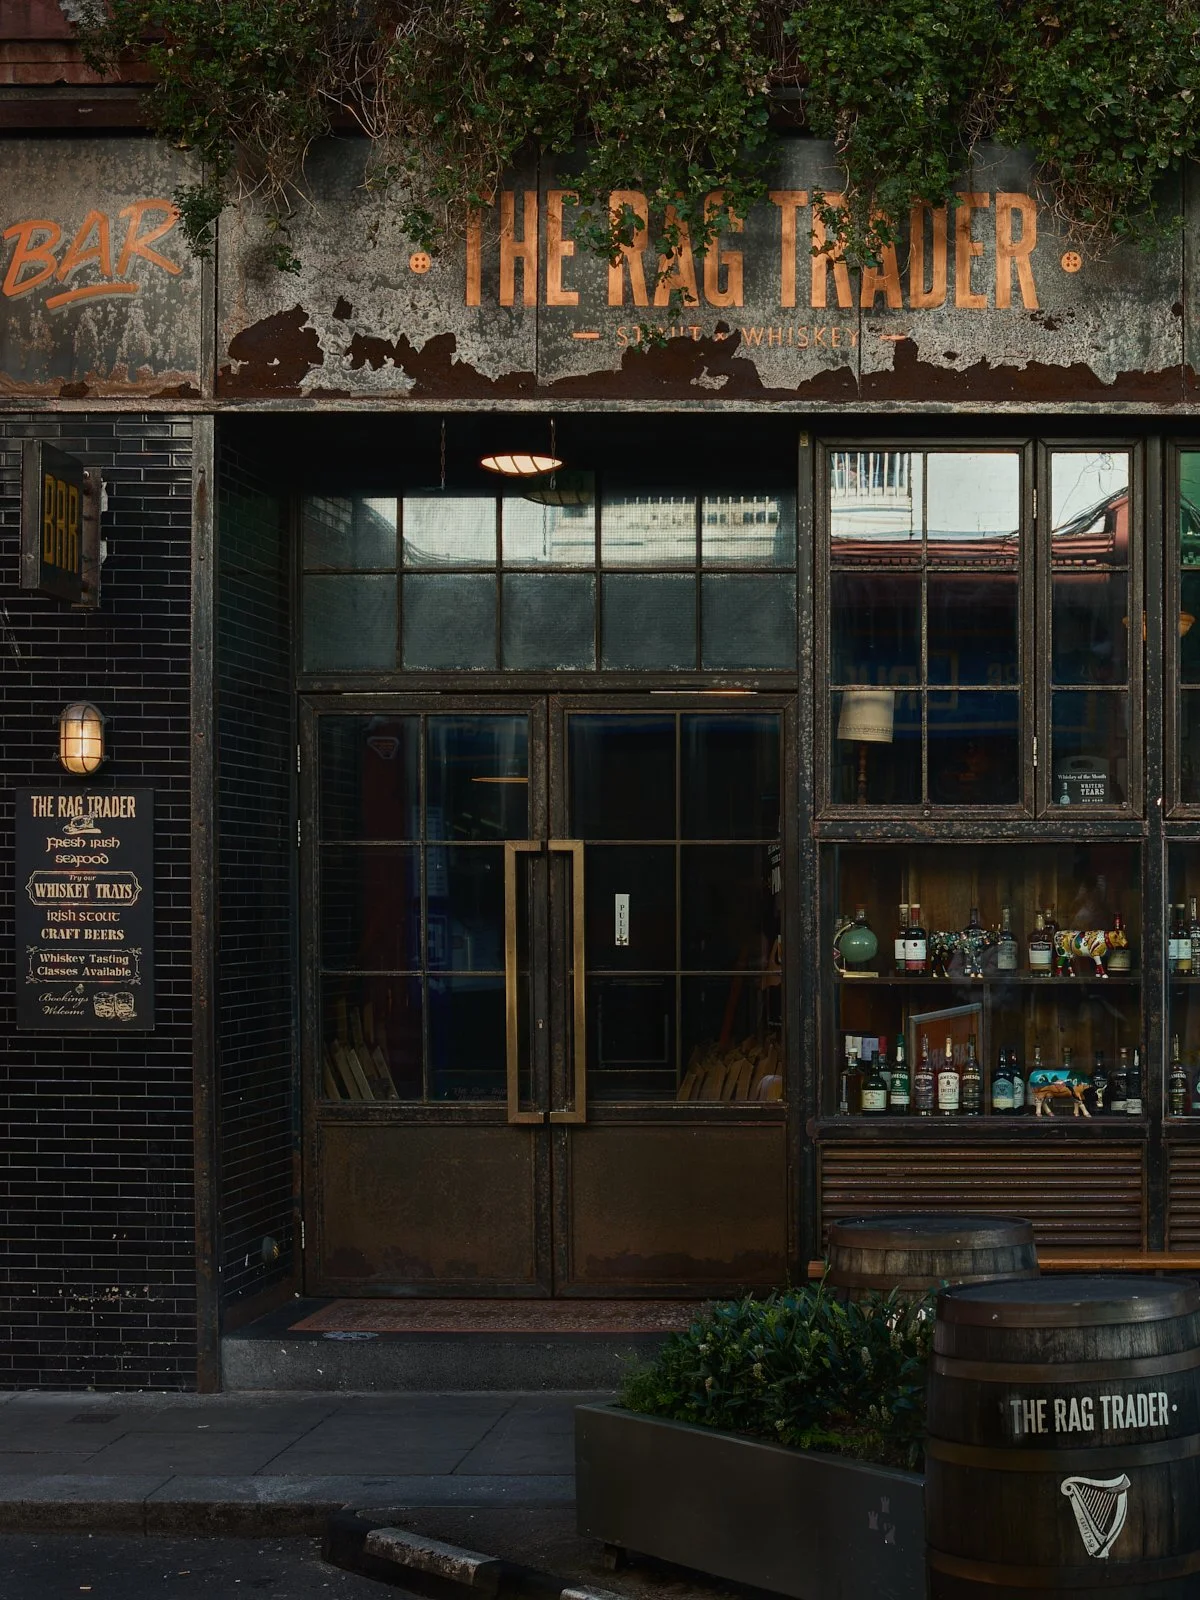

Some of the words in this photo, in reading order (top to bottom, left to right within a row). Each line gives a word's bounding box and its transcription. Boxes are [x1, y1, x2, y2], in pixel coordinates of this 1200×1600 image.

[2, 199, 182, 298] BAR
[456, 190, 580, 307] THE
[608, 190, 745, 308] RAG
[769, 190, 1040, 310] TRADER
[616, 325, 702, 346] STUT
[741, 326, 861, 349] WHISKEY
[43, 473, 79, 574] BAR
[31, 795, 54, 818] THE
[58, 795, 83, 818] RAG
[87, 795, 136, 818] TRADER
[69, 874, 83, 882] Try
[34, 883, 90, 899] WHISKEY
[96, 883, 133, 899] TRAYS
[41, 928, 81, 940] CRAFT
[84, 929, 125, 941] BEERS
[40, 953, 86, 965] Whiskey
[89, 953, 129, 966] Tasting
[37, 966, 79, 976] Classes
[82, 966, 132, 977] Available
[38, 990, 89, 1009] Bookings
[42, 1005, 85, 1016] Welcome
[1010, 1399, 1049, 1434] THE
[1055, 1396, 1095, 1433] RAG
[1100, 1392, 1170, 1430] TRADER
